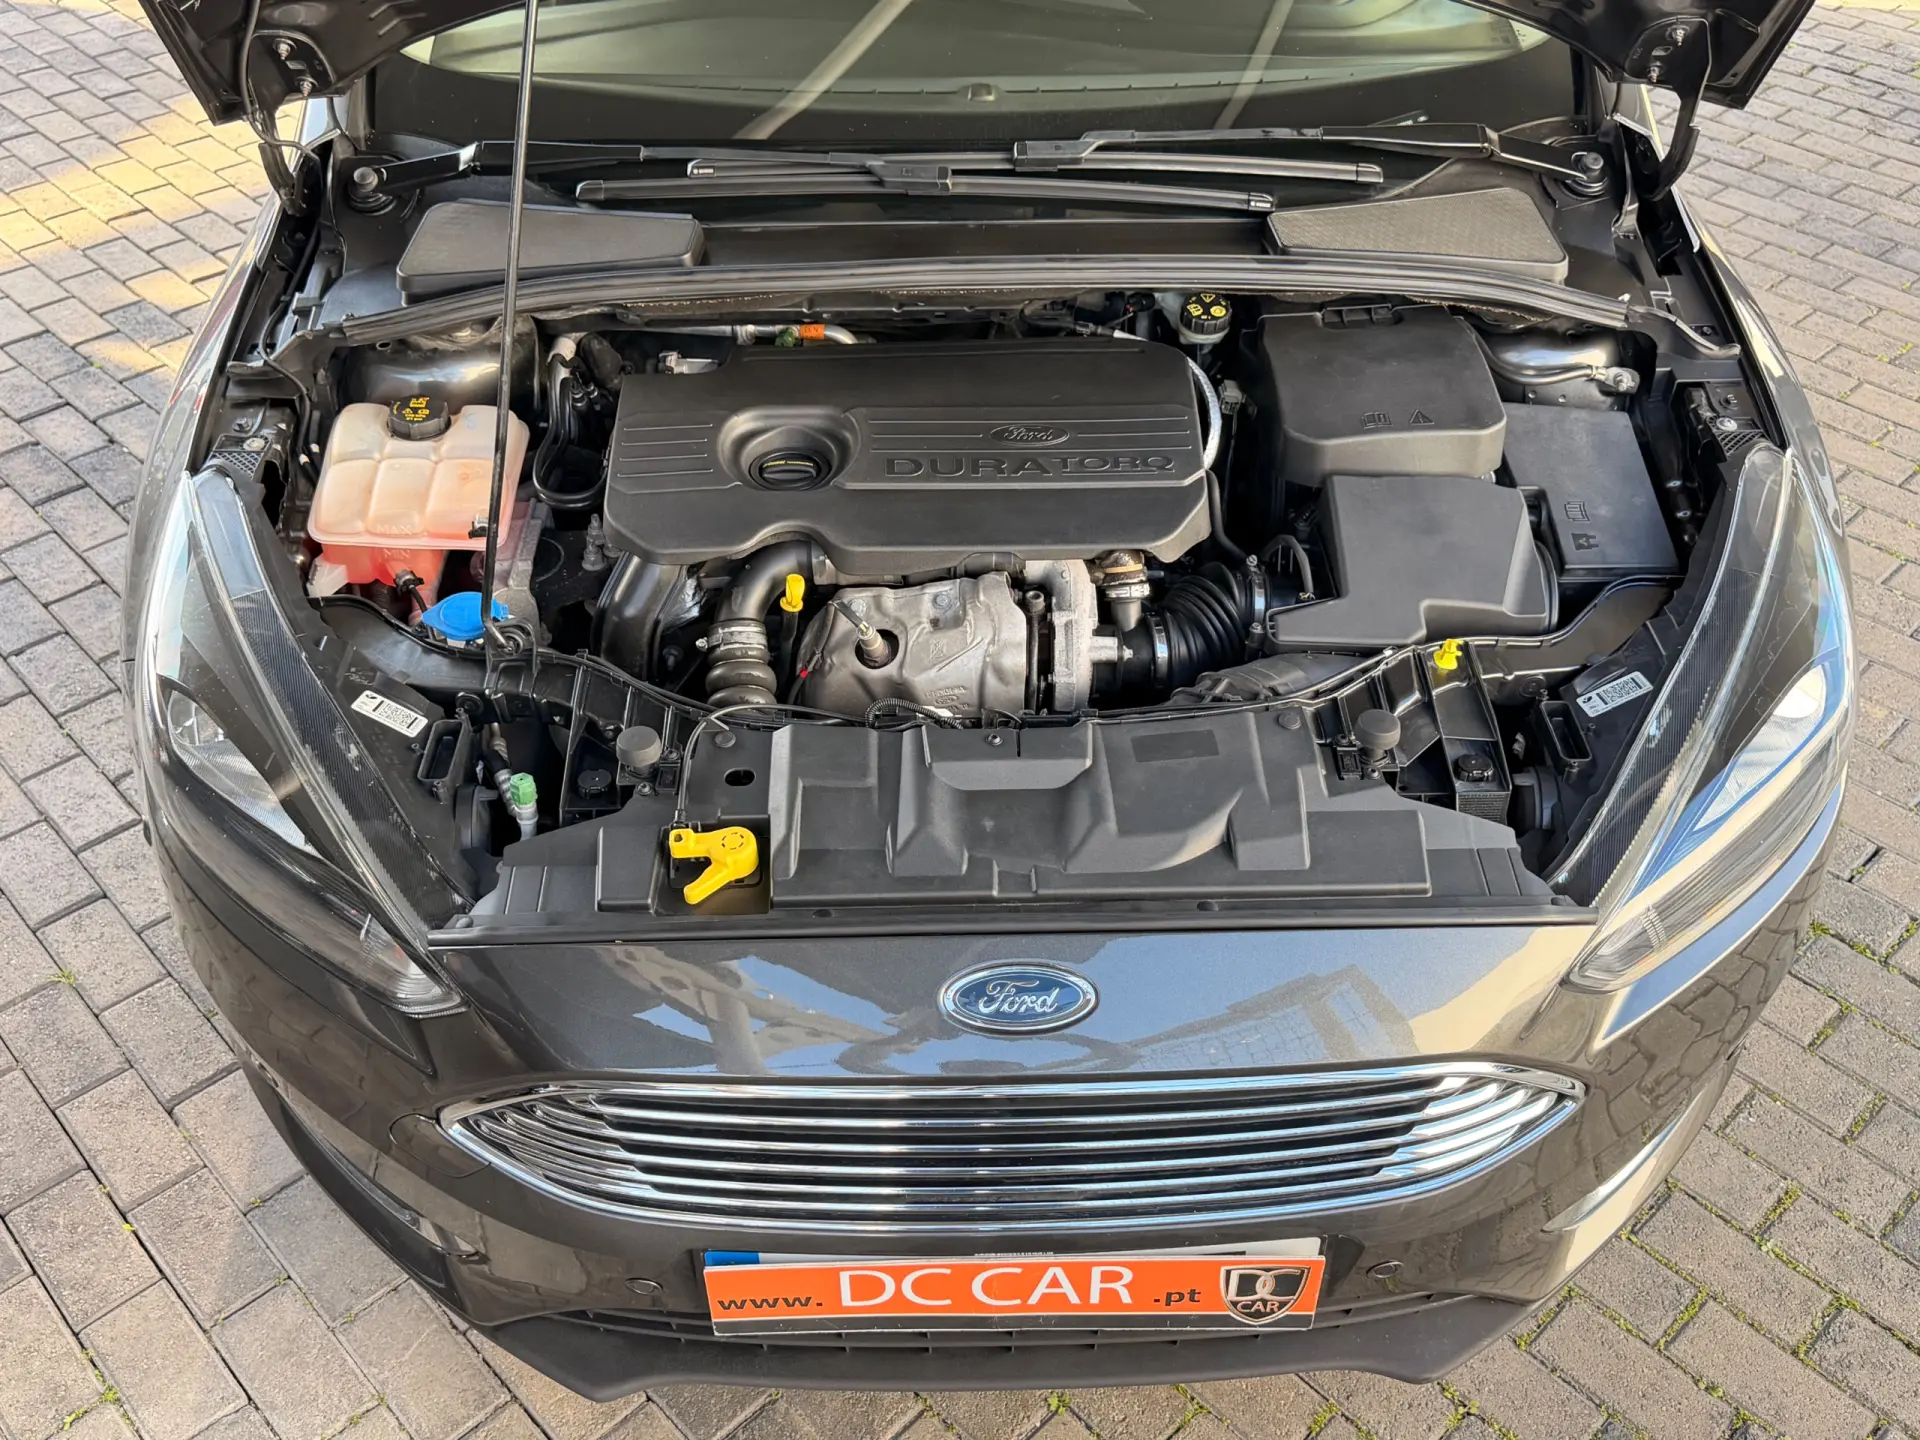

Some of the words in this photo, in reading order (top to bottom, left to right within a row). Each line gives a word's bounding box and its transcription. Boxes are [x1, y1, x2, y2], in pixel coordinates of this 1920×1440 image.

[1003, 426, 1055, 441] Ford
[884, 456, 1176, 477] DURATORQ
[375, 524, 413, 536] MAX
[978, 980, 1060, 1014] Ford
[717, 1296, 823, 1311] www.
[839, 1267, 953, 1307] DC
[971, 1265, 1134, 1306] CAR
[1153, 1288, 1202, 1307] .pt
[1227, 1268, 1302, 1301] DC
[1236, 1301, 1280, 1313] CAR
